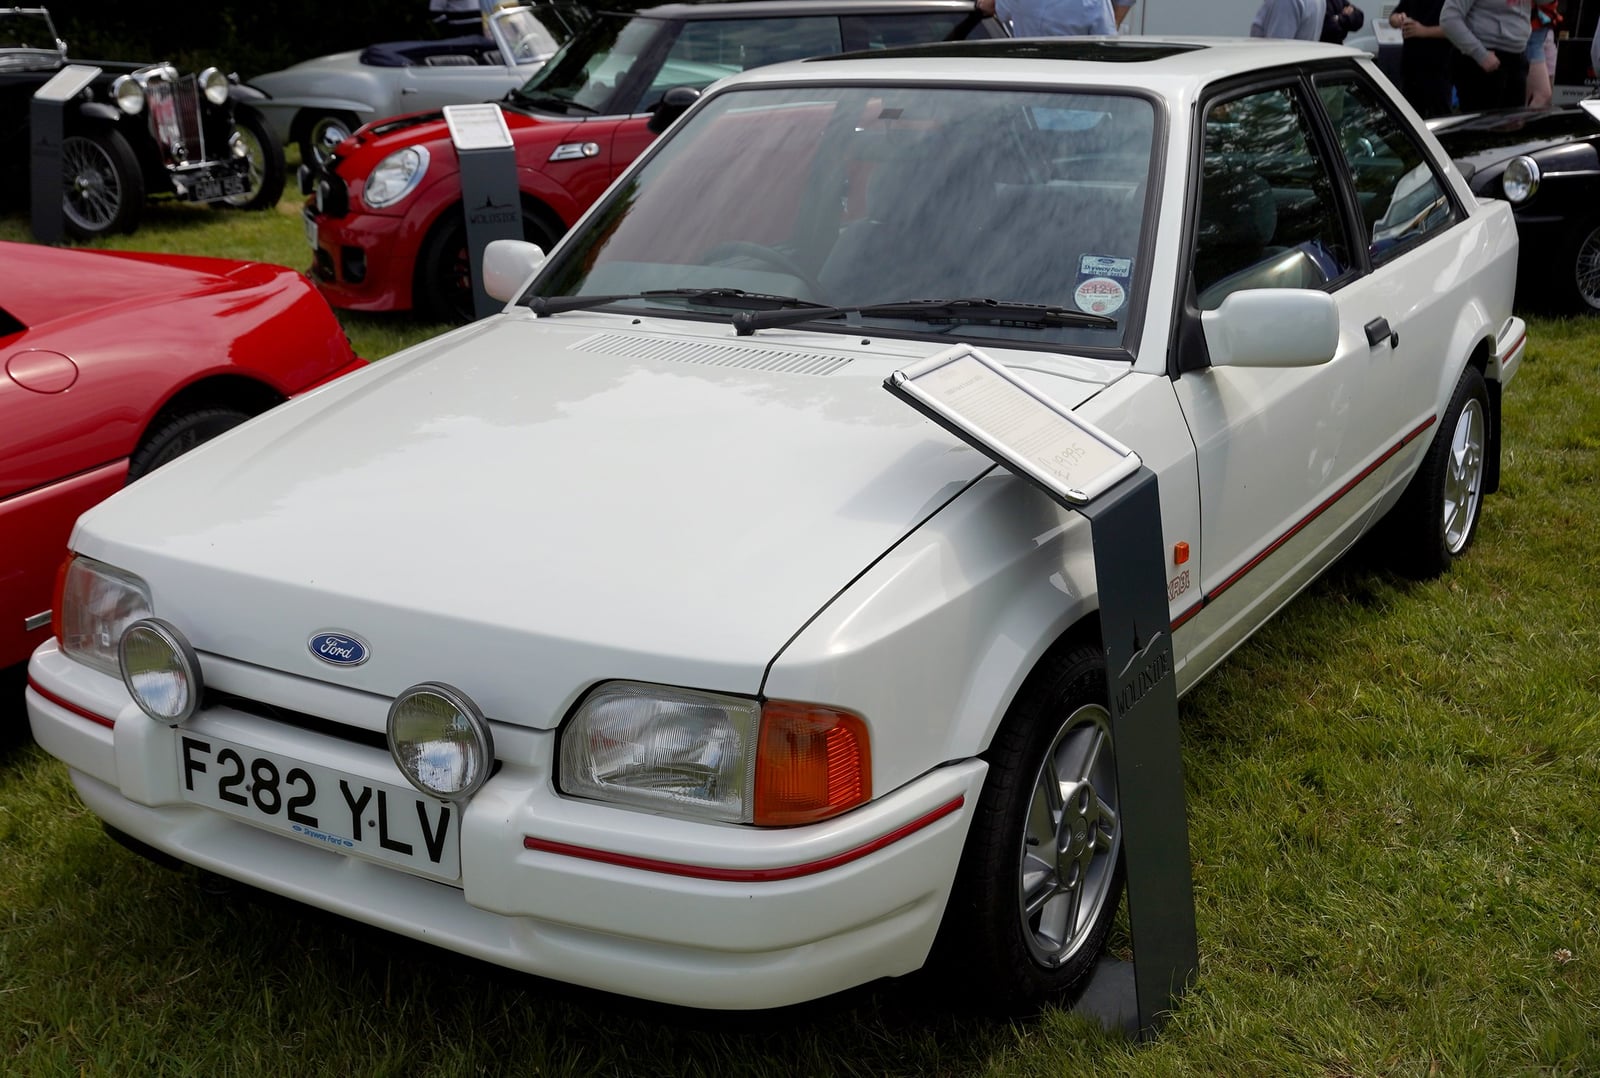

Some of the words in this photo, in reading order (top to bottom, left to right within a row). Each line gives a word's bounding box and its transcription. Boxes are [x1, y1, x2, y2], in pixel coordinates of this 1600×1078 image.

[320, 636, 355, 659] Ford
[1115, 648, 1170, 719] WOLDSIDE
[182, 736, 319, 828] F282
[339, 779, 451, 864] YLV
[327, 835, 342, 846] Ford
